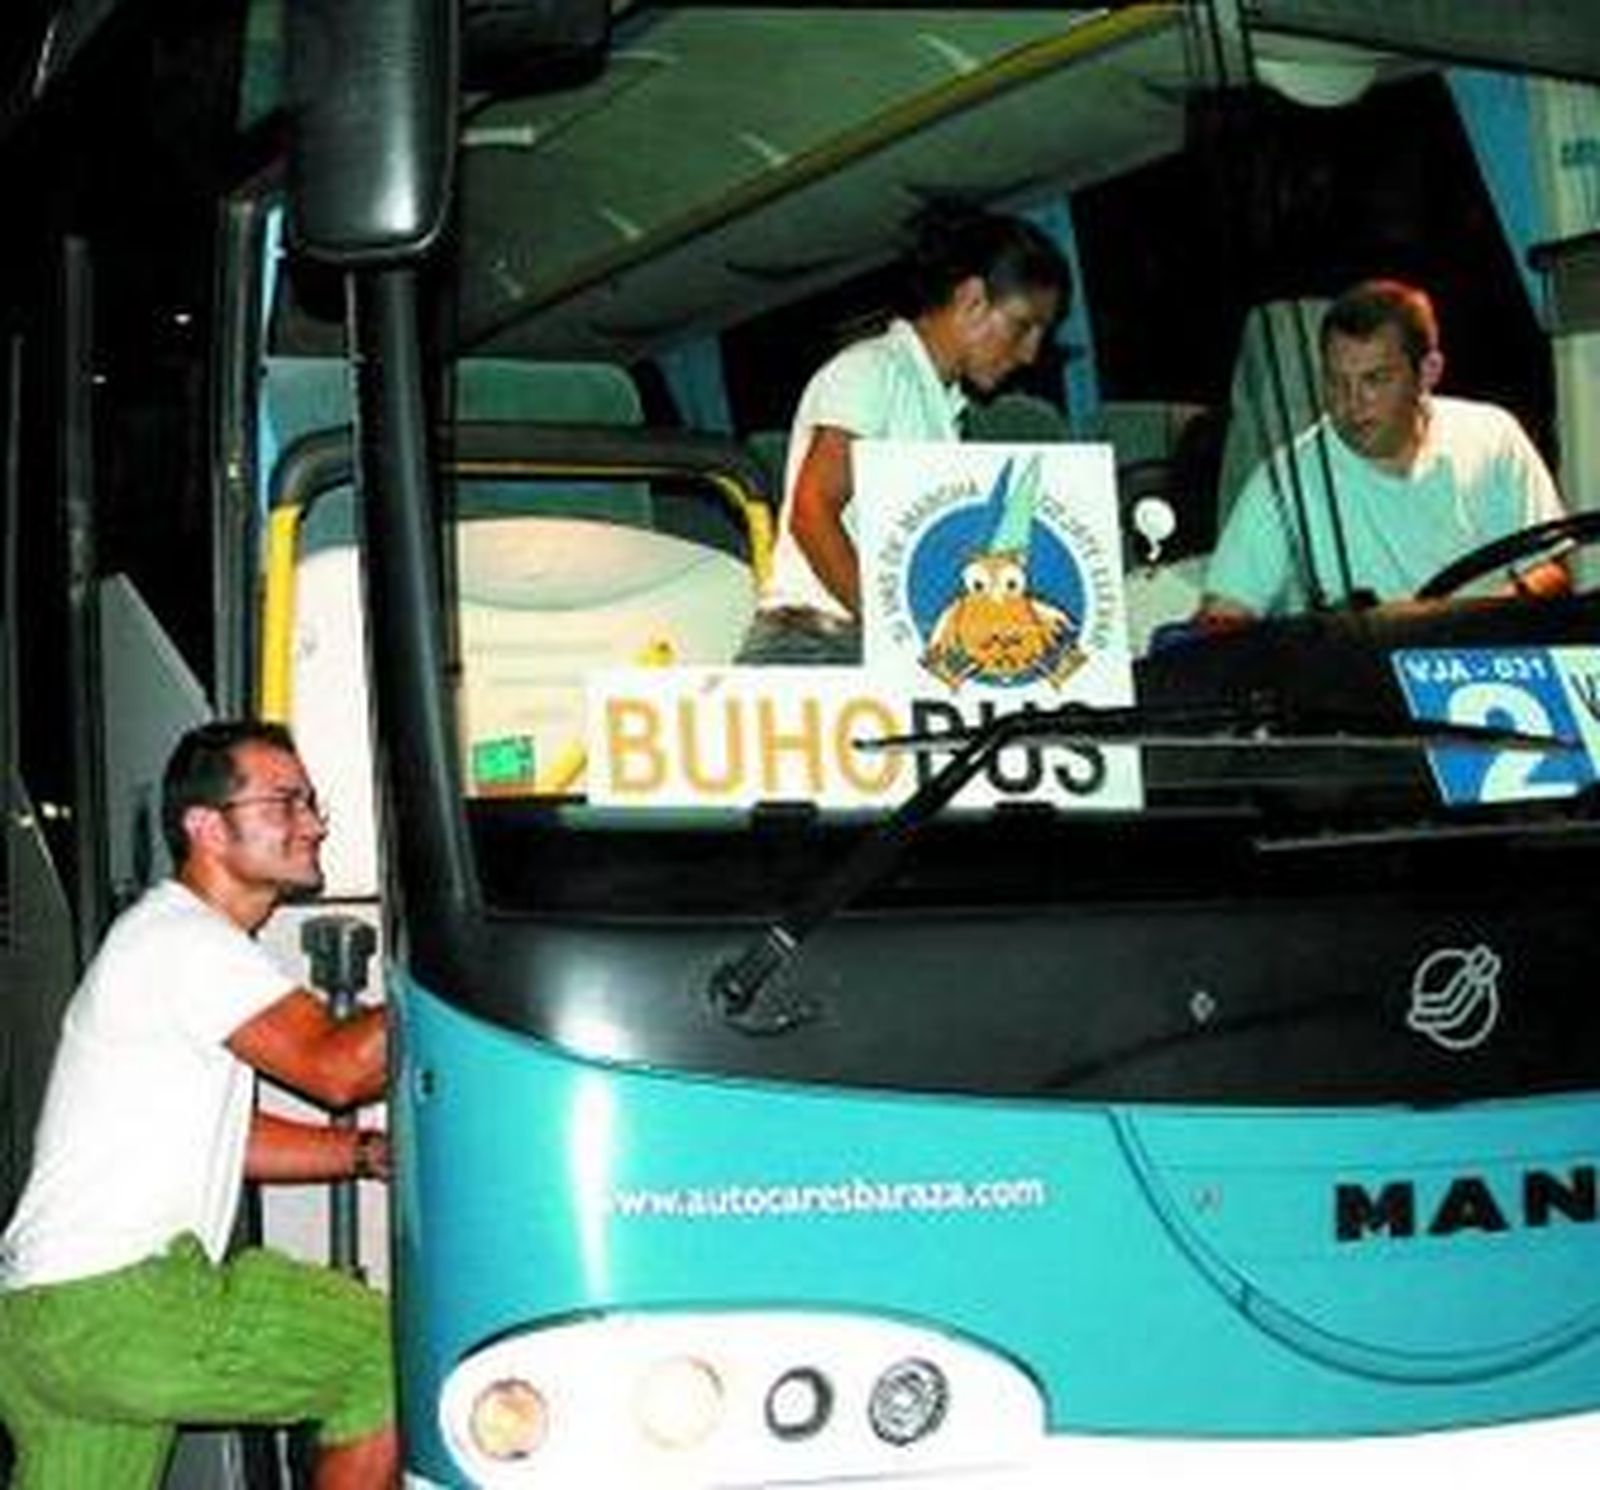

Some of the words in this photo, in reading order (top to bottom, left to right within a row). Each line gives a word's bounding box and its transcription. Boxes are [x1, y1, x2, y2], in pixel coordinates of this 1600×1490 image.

[1447, 682, 1580, 803] 2
[610, 1177, 1046, 1217] ww.autocaresbaraza.com
[1334, 1165, 1596, 1242] MAN
